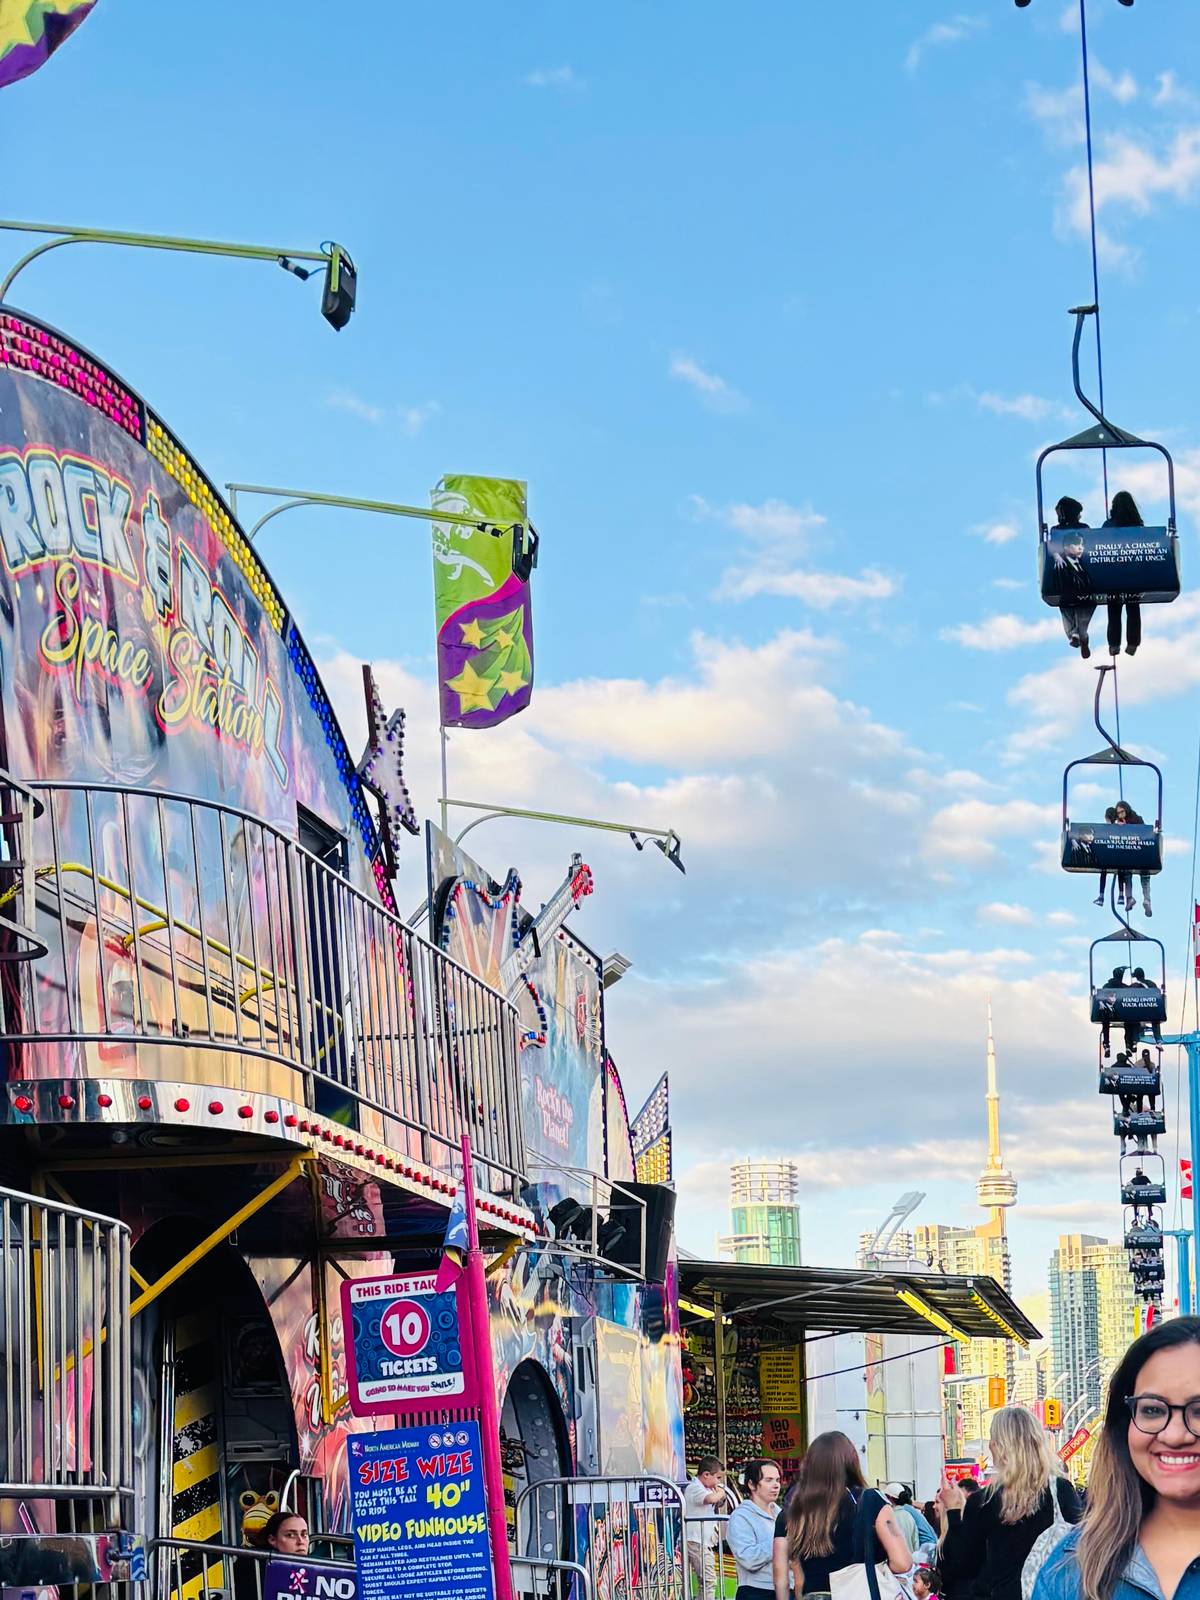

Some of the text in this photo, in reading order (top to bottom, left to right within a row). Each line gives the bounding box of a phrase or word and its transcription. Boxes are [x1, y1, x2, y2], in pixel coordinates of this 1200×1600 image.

[0, 452, 138, 582] ROCK
[1090, 556, 1116, 564] ENTIRE
[1117, 555, 1134, 563] CITY
[41, 562, 150, 700] Space
[160, 630, 264, 750] Station
[356, 1279, 436, 1298] THIS RIDE TAK
[385, 1312, 423, 1346] 10
[380, 1356, 438, 1377] TICKETS
[416, 1384, 430, 1393] YOU
[358, 1449, 474, 1485] SIZE WIZE
[354, 1485, 418, 1500] YOU MUST BE AT
[355, 1494, 417, 1508] LEAST THIS TALL
[355, 1506, 387, 1517] TO RIDE
[357, 1512, 487, 1543] VIDEO FUNHOUSE
[315, 1575, 356, 1599] NO
